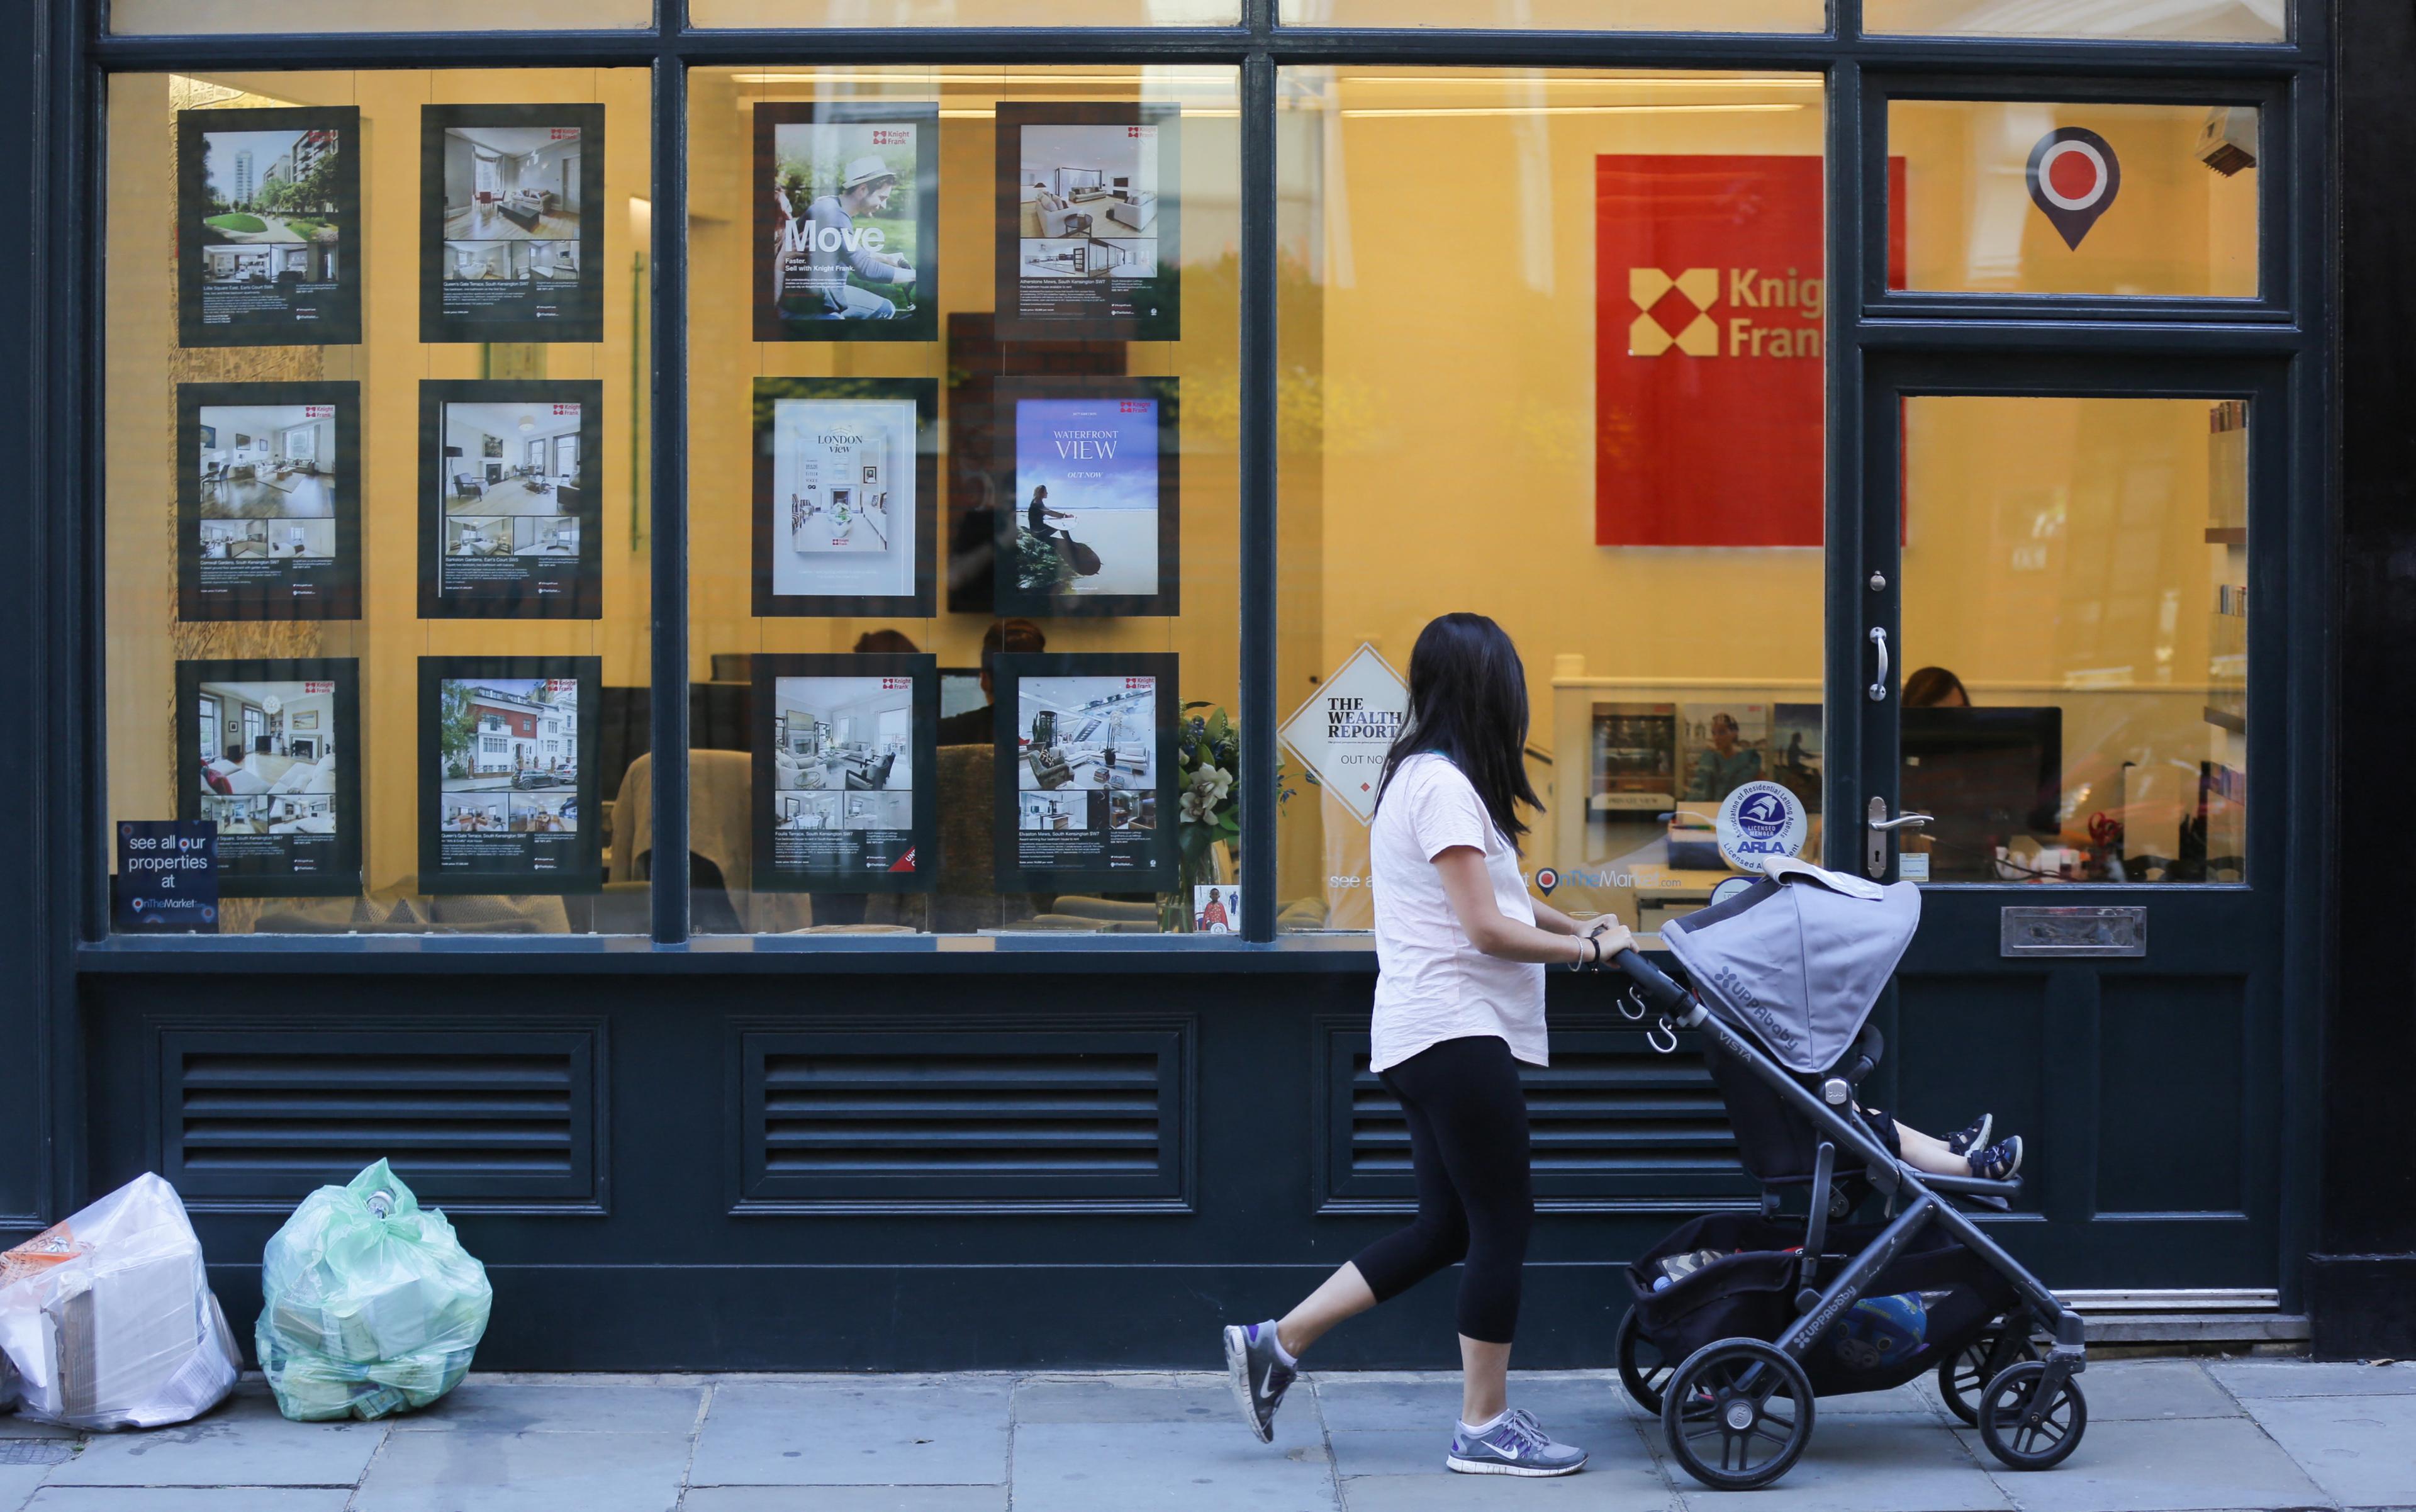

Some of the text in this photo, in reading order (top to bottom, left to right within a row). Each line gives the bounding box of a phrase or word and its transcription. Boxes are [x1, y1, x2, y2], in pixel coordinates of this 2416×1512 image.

[785, 220, 885, 252] Move
[1730, 268, 1824, 318] Knig
[1730, 318, 1820, 358] Fran
[818, 435, 863, 444] LONDON
[1054, 430, 1119, 439] WATERFRONT
[829, 444, 851, 453] view
[1055, 440, 1118, 459] VIEW
[1328, 698, 1363, 710] THE
[1328, 712, 1402, 724] WEALTH
[1328, 725, 1398, 738] REPORT
[1341, 755, 1386, 764] OUT NO
[1743, 783, 1781, 795] Residential
[1779, 793, 1793, 815] Letting
[1730, 800, 1743, 838] Association
[1780, 817, 1794, 838] Agents
[130, 835, 206, 852] see all our
[1737, 841, 1786, 853] ARLA
[128, 854, 208, 872] properties
[1724, 843, 1754, 868] Licensed
[161, 875, 175, 888] at
[1330, 876, 1360, 888] see
[1732, 982, 1798, 1051] UPPAbaby
[1718, 1031, 1752, 1062] VISTA
[1805, 1285, 1857, 1336] UPPAbaby
